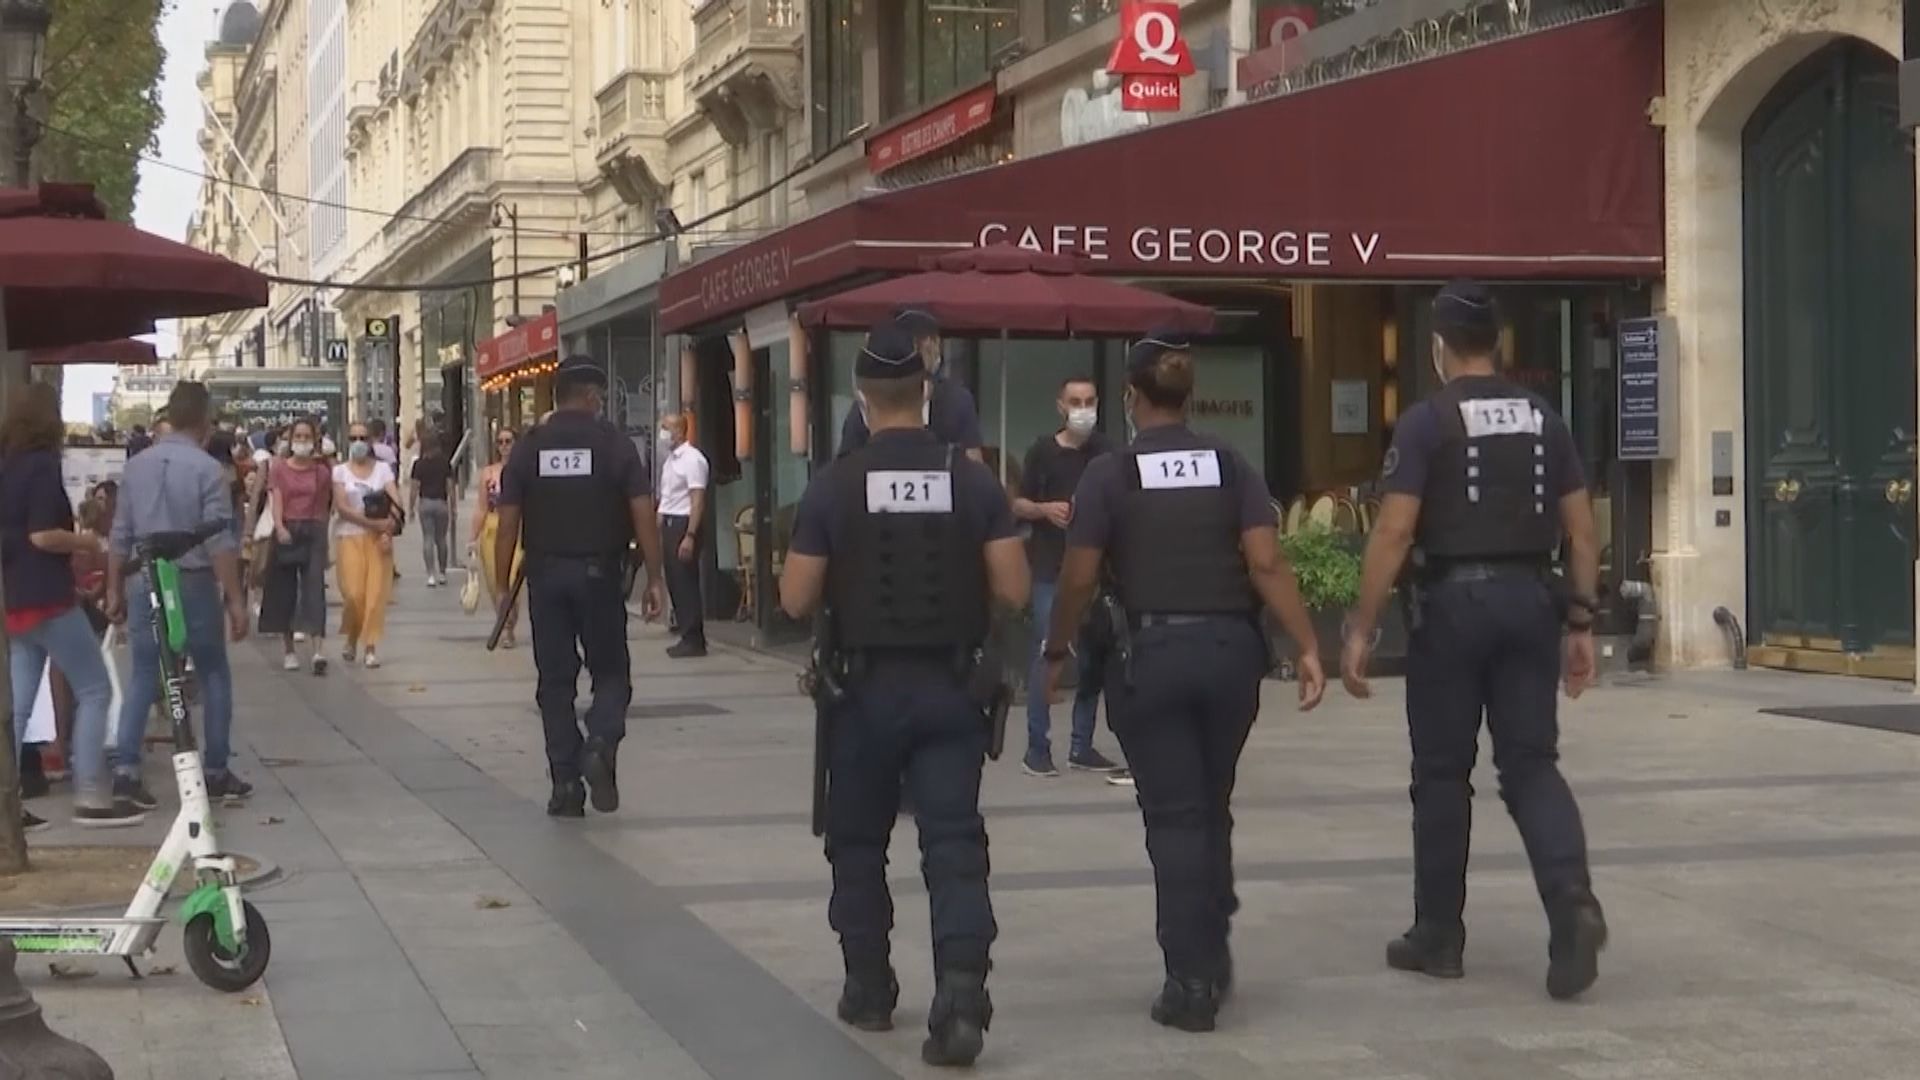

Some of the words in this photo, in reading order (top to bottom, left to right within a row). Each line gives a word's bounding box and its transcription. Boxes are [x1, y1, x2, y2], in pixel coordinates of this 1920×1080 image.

[1135, 12, 1180, 65] Q
[1129, 82, 1178, 99] Quick
[979, 224, 1108, 259] CAFE
[1131, 227, 1332, 265] GEORGE
[1351, 232, 1379, 265] V
[701, 269, 728, 309] CAFE
[732, 251, 780, 296] GEORGE
[781, 244, 791, 279] V
[1483, 407, 1516, 425] 121
[550, 456, 580, 469] C12
[1160, 460, 1199, 478] 121
[889, 482, 929, 501] 121
